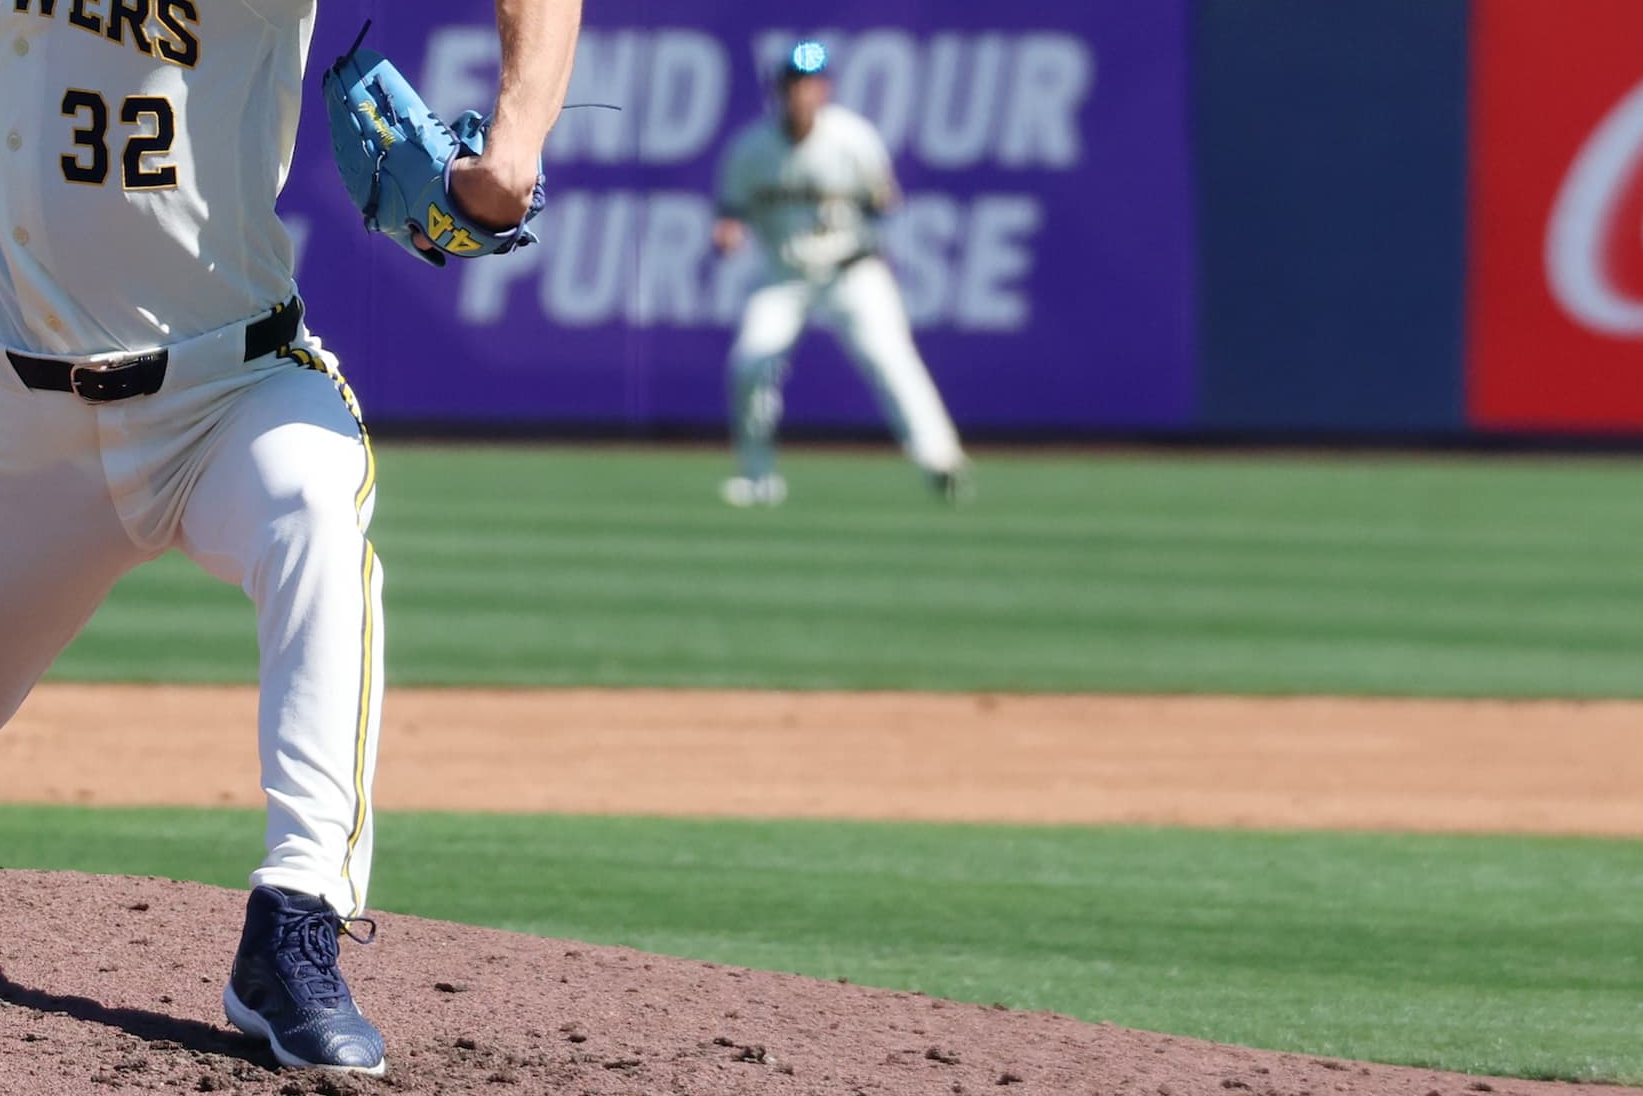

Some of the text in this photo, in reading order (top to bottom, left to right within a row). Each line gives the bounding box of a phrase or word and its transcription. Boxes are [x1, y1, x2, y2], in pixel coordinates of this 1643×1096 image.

[60, 88, 180, 191] 32
[422, 26, 730, 164] FND
[428, 201, 484, 252] 44
[460, 187, 1044, 332] PURSE
